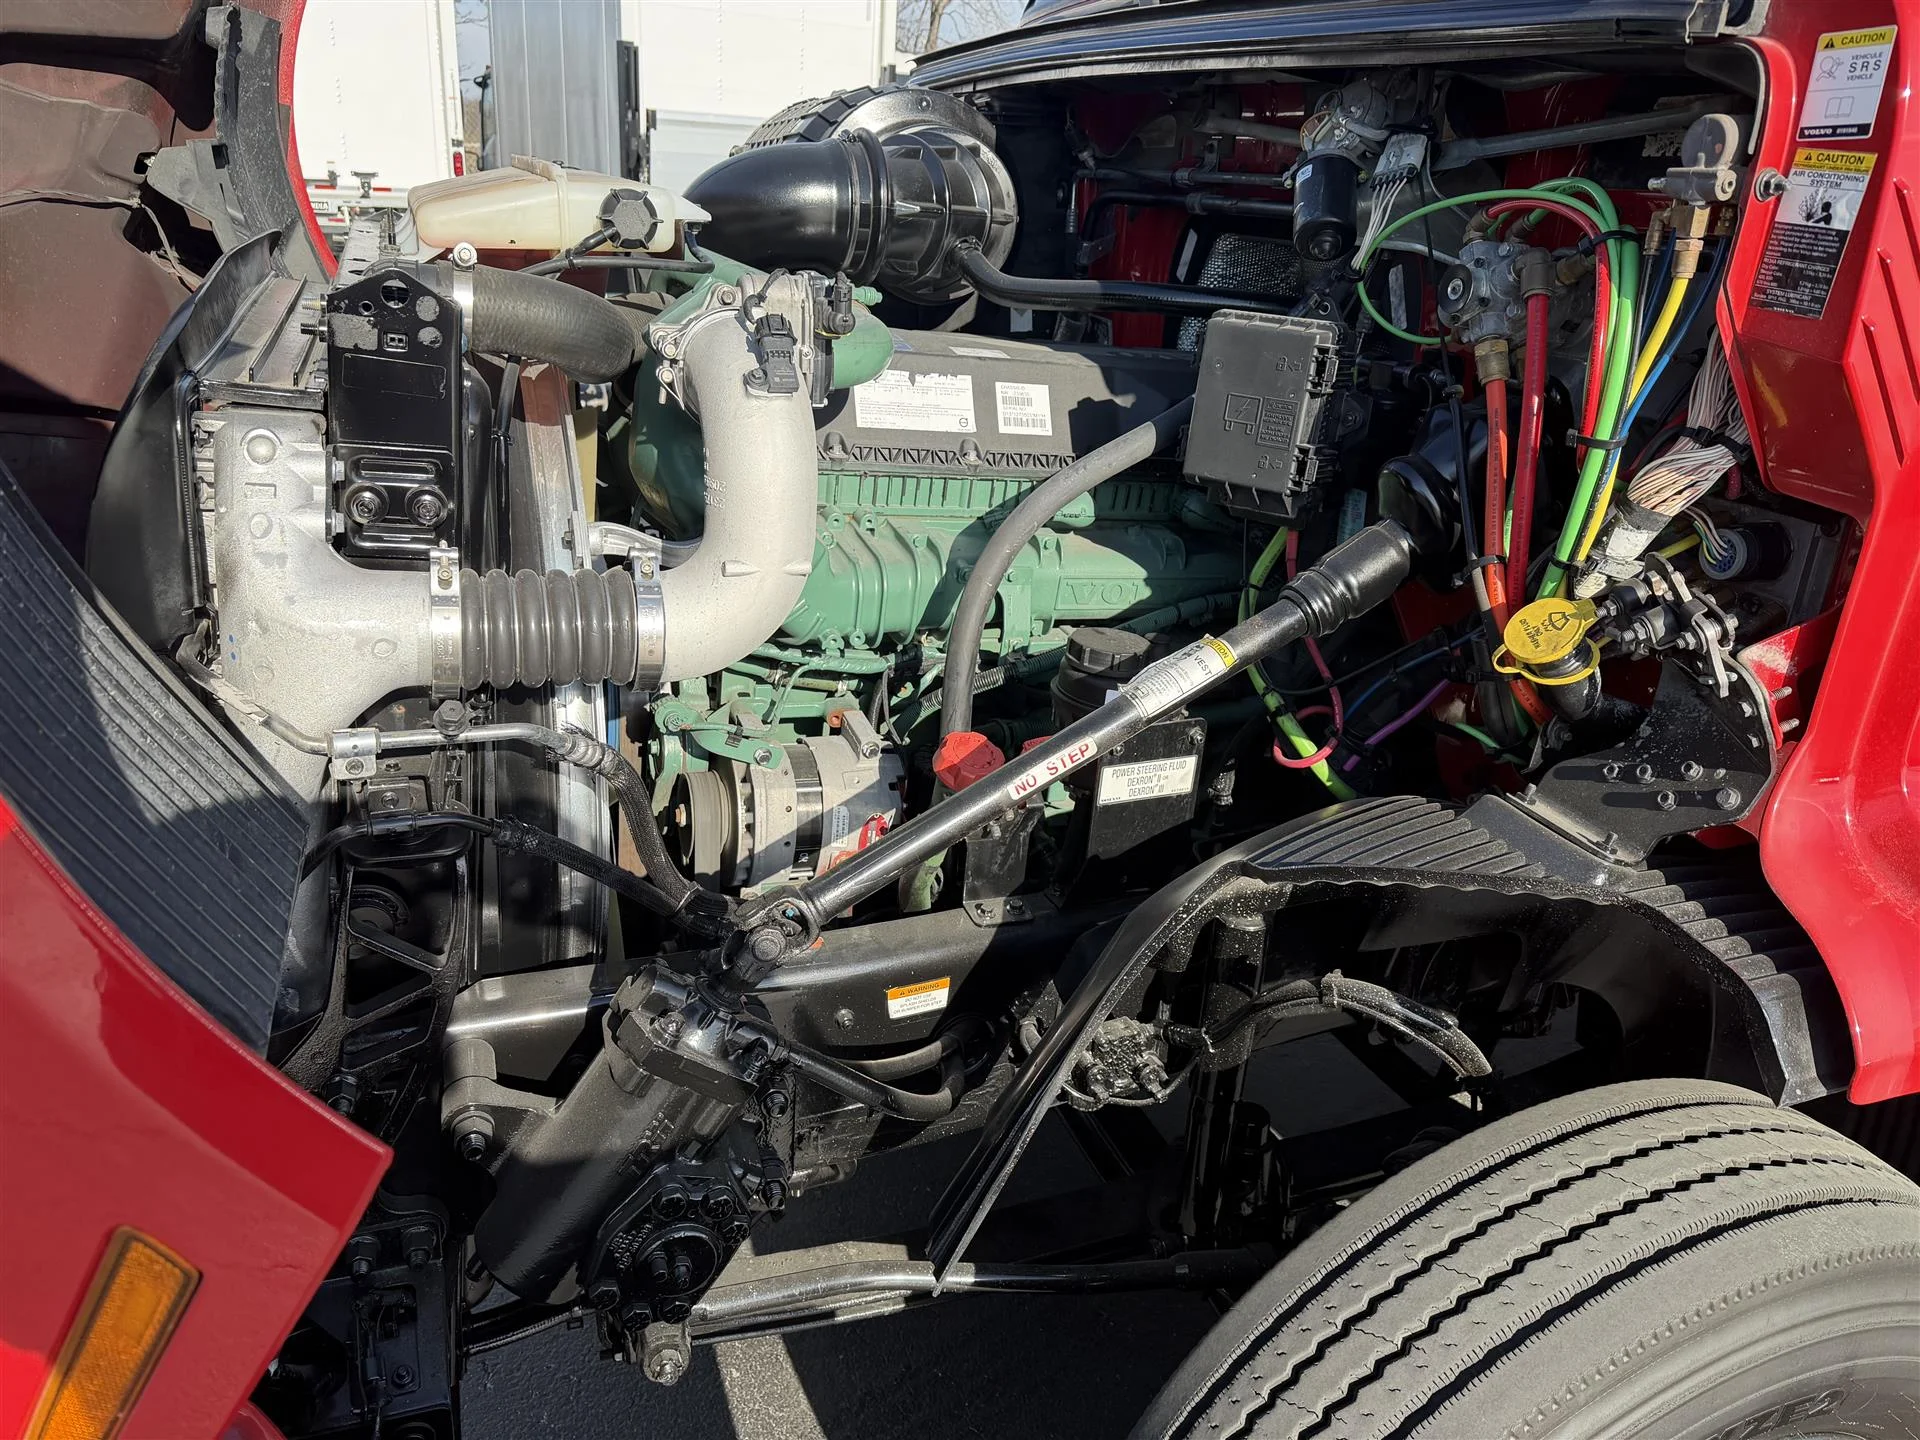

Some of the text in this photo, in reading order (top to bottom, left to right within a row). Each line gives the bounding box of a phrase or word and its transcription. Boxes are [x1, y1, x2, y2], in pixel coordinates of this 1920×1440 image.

[1841, 32, 1887, 45] CAUTION
[1851, 51, 1884, 60] VEHICULE
[1846, 73, 1873, 81] VEHICLE
[1803, 127, 1833, 136] VOLVO
[1816, 152, 1865, 165] CAUTION
[1807, 171, 1865, 182] CONDITIONING
[1809, 179, 1842, 188] SYSTEM
[1765, 288, 1787, 296] SYSTEM
[1206, 639, 1229, 659] AUTION
[1194, 655, 1213, 676] VEST
[1014, 743, 1089, 795] NO STEP
[1112, 760, 1187, 778] POWER STEERING FLUID
[908, 984, 939, 993] WARNING
